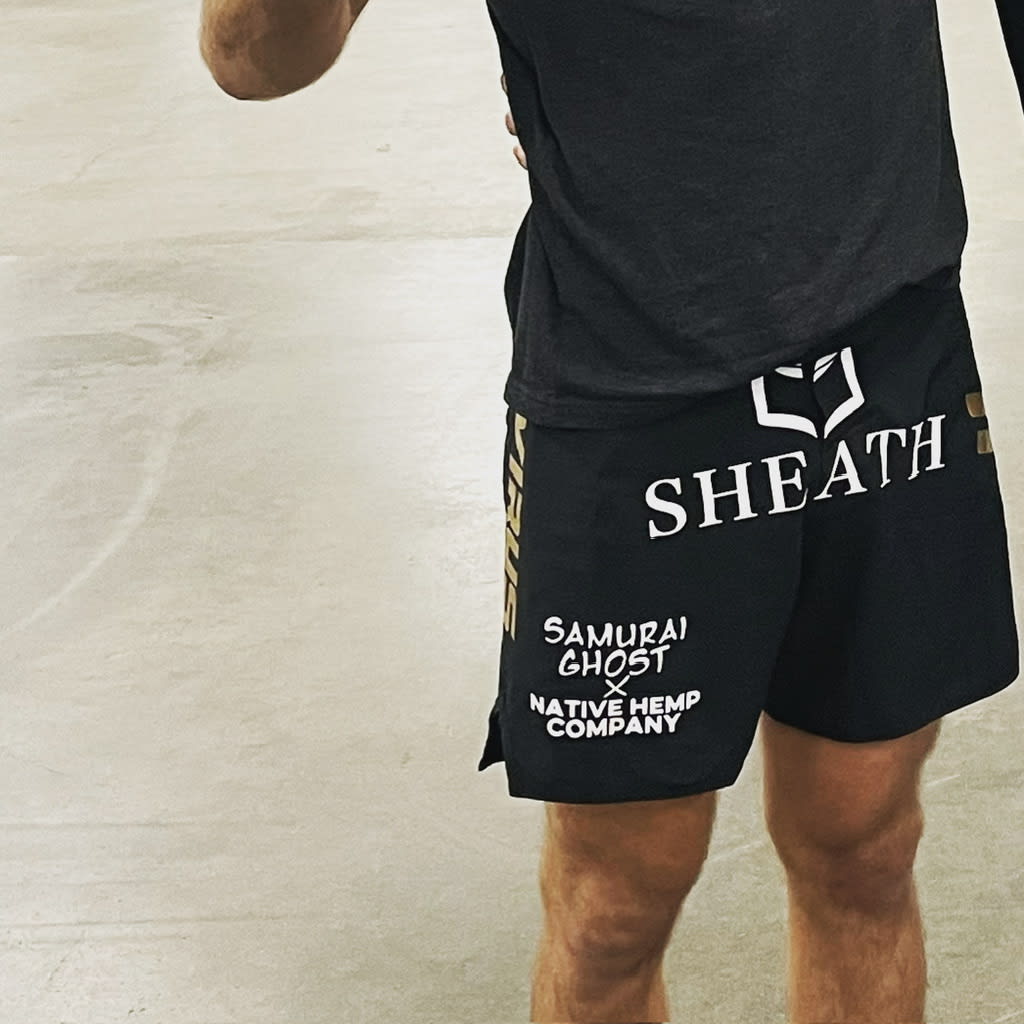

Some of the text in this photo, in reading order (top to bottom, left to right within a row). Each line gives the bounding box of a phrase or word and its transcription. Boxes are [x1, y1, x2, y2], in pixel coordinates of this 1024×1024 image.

[643, 414, 947, 539] SHEATH
[503, 412, 527, 641] VIRUS
[543, 615, 687, 649] SAMURAI
[558, 644, 671, 678] GHOST
[529, 689, 701, 719] NATIVE HEMP
[546, 712, 682, 739] COMPANY
